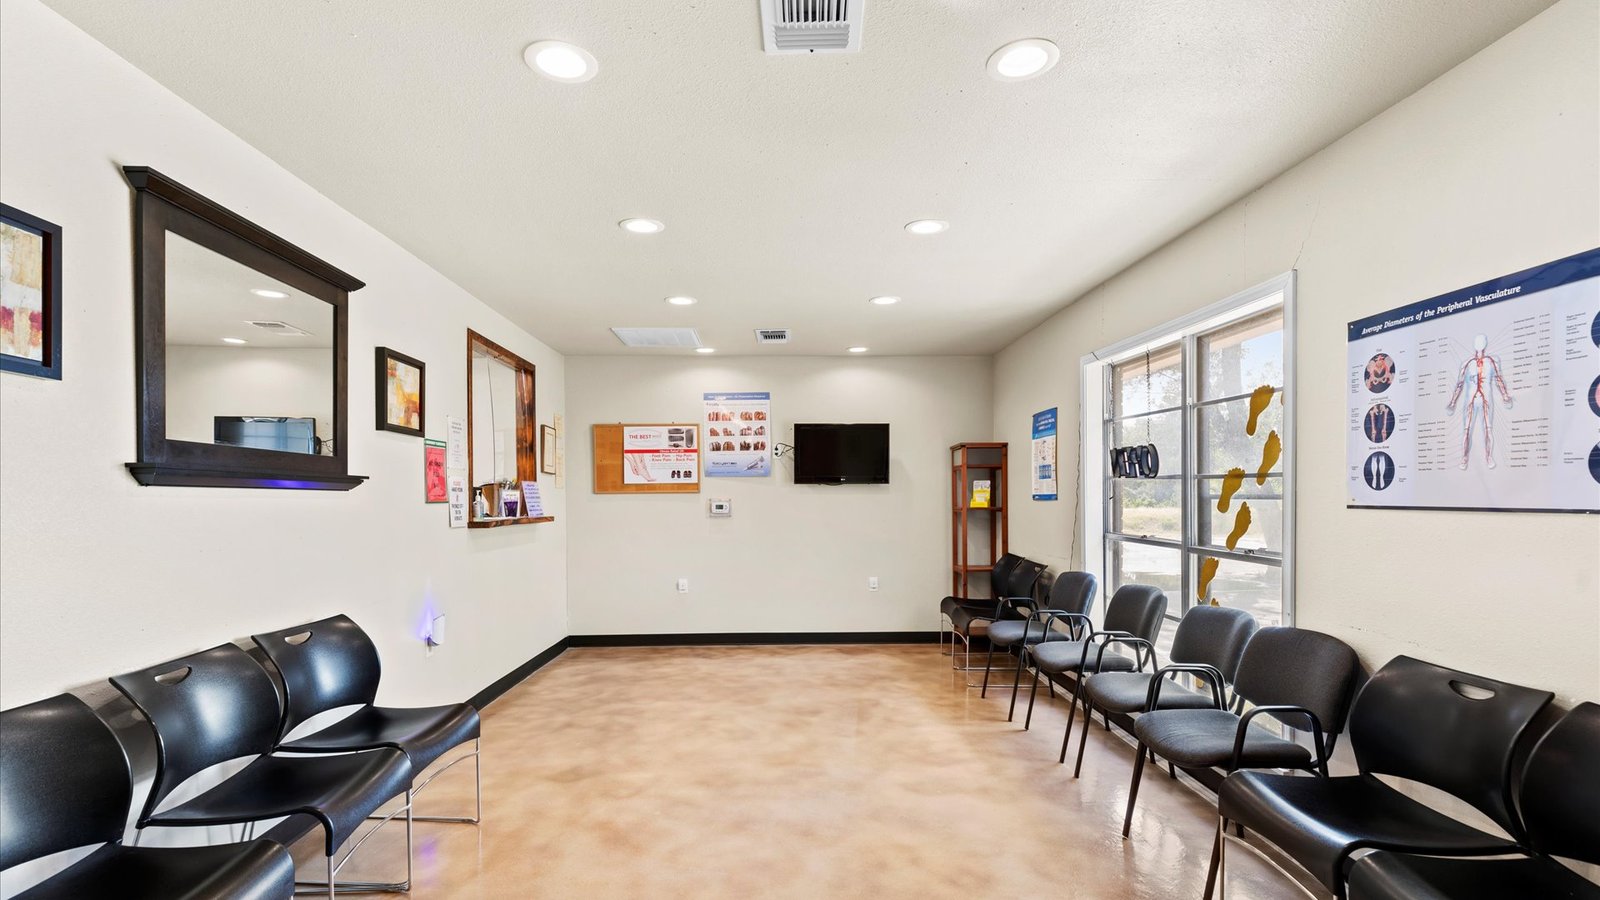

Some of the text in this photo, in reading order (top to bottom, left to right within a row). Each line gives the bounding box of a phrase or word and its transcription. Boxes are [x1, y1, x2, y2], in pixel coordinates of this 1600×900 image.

[1361, 286, 1521, 335] Average Diameters of the Peripheral Vasculature
